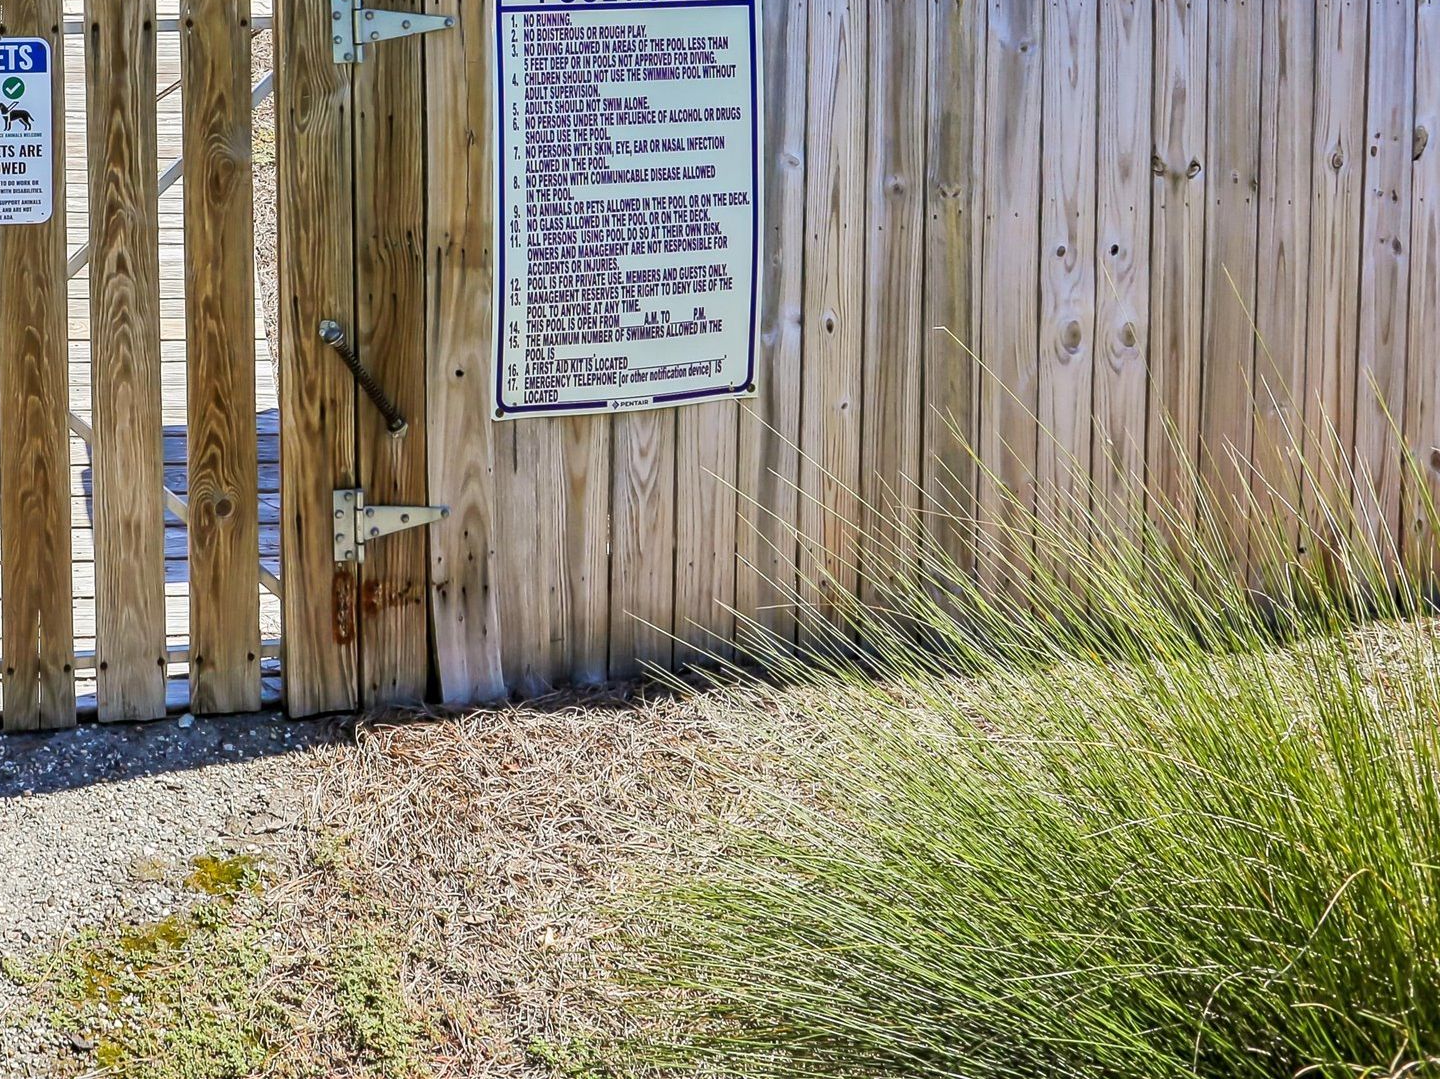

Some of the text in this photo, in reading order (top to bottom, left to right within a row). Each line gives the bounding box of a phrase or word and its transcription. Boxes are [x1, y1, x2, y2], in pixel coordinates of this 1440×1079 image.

[511, 12, 572, 27] 1. NO RUNNING.
[511, 24, 647, 42] 2. NO BOISTEROUS OR ROUGH PLAY.
[511, 64, 736, 86] 4. CHILDREN SHOULD NOT USE THE SWIMMING POOL WITHOUT
[524, 83, 600, 100] ADULT SUPERVISION.
[512, 96, 650, 115] 5. ADULTS SHOULD NOT SWIM ALONE.
[19, 144, 42, 157] ARE
[526, 235, 727, 261] OWNERS AND MANAGEMENT ARE NOT RESPONSIBLE FOR
[527, 256, 619, 276] ACCIDENTS OR INJURIES.
[510, 263, 727, 291] 12. POOL IS FOR PRIVATE USE. MEMBERS AND GUESTS ONLY.
[620, 399, 649, 407] PENTAIR
